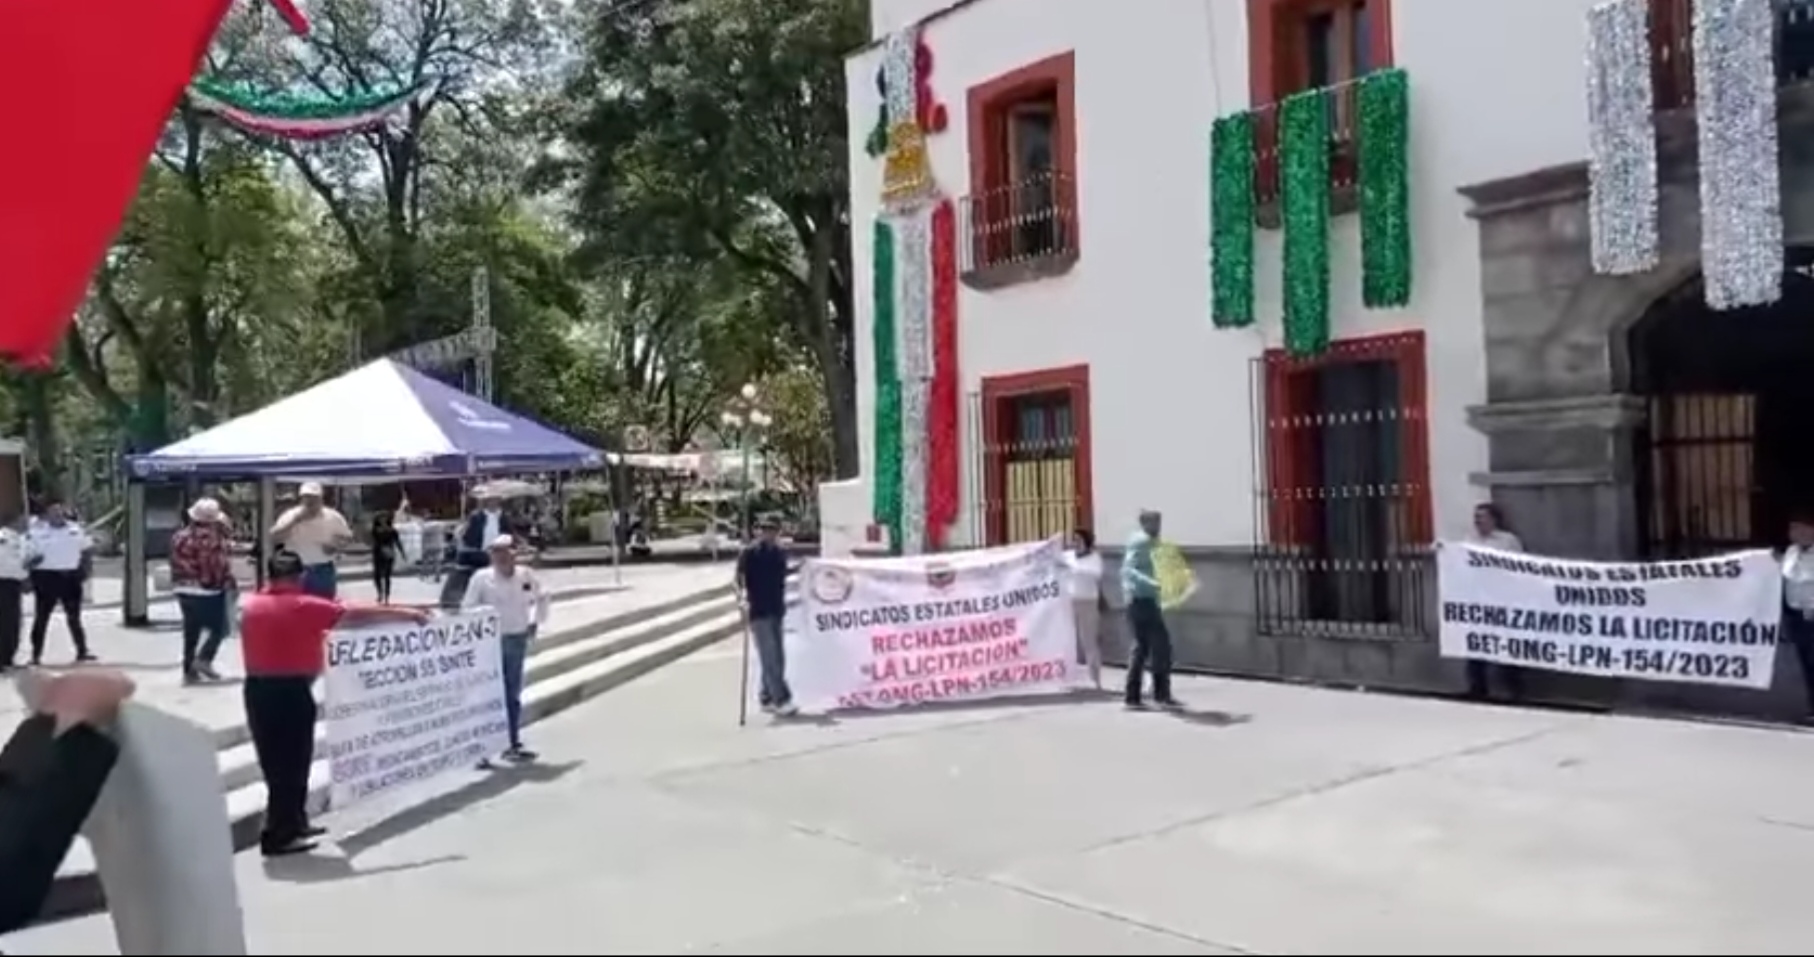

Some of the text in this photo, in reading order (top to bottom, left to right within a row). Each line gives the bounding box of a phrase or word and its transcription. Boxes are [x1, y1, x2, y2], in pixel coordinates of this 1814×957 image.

[816, 581, 1061, 632] SINDICATOS ESTATALES UNIDOS
[1555, 585, 1646, 607] UNIDOS
[871, 618, 1016, 654] RECHAZAMOS
[1444, 602, 1776, 647] RECHAZAMOS LA LICITACIÓN
[1466, 632, 1749, 678] GET-OMG-LPN-154/2023
